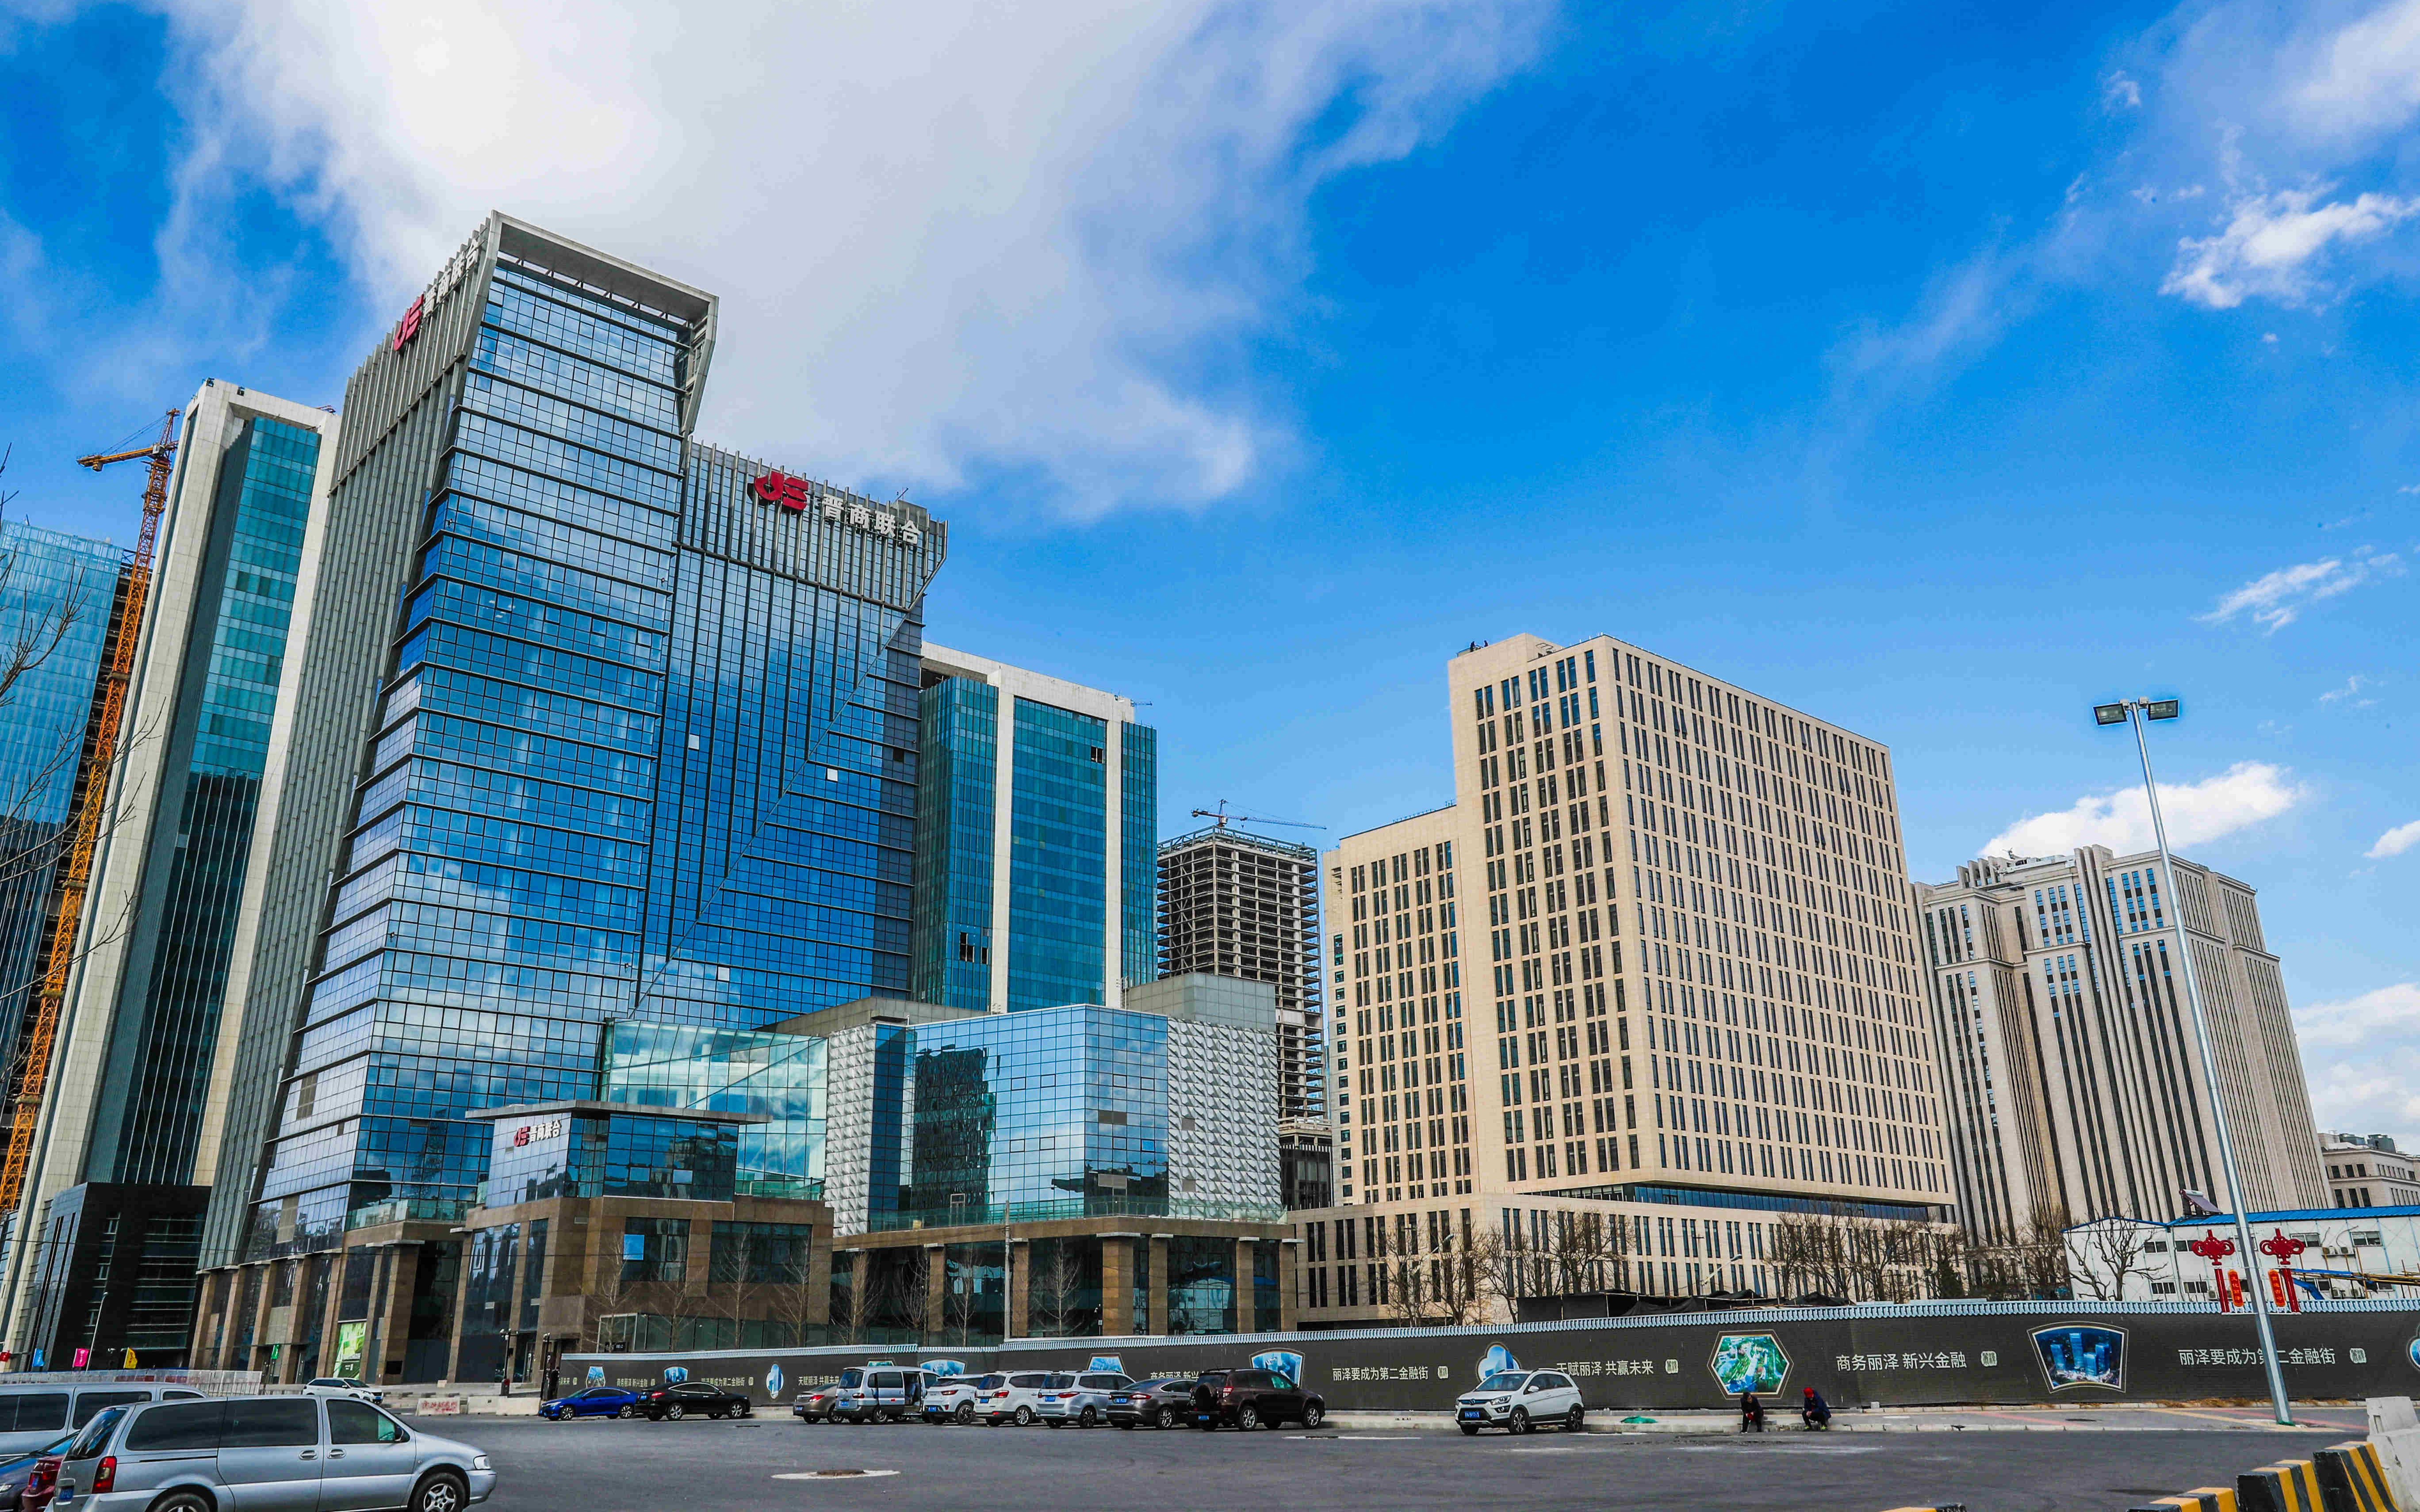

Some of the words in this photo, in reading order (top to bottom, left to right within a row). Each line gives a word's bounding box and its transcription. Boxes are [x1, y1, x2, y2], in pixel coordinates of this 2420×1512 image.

[822, 493, 921, 545] 晋商联合
[529, 1119, 562, 1142] 晋商联合
[1556, 1361, 1602, 1376] 天赋丽泽
[1605, 1359, 1654, 1376] 共赢未来
[1836, 1354, 1899, 1371] 商务丽泽
[1902, 1351, 1967, 1369] 新兴金融
[1183, 1371, 1199, 1381] 新兴
[1332, 1366, 1428, 1381] 丽泽要成为第二金融街
